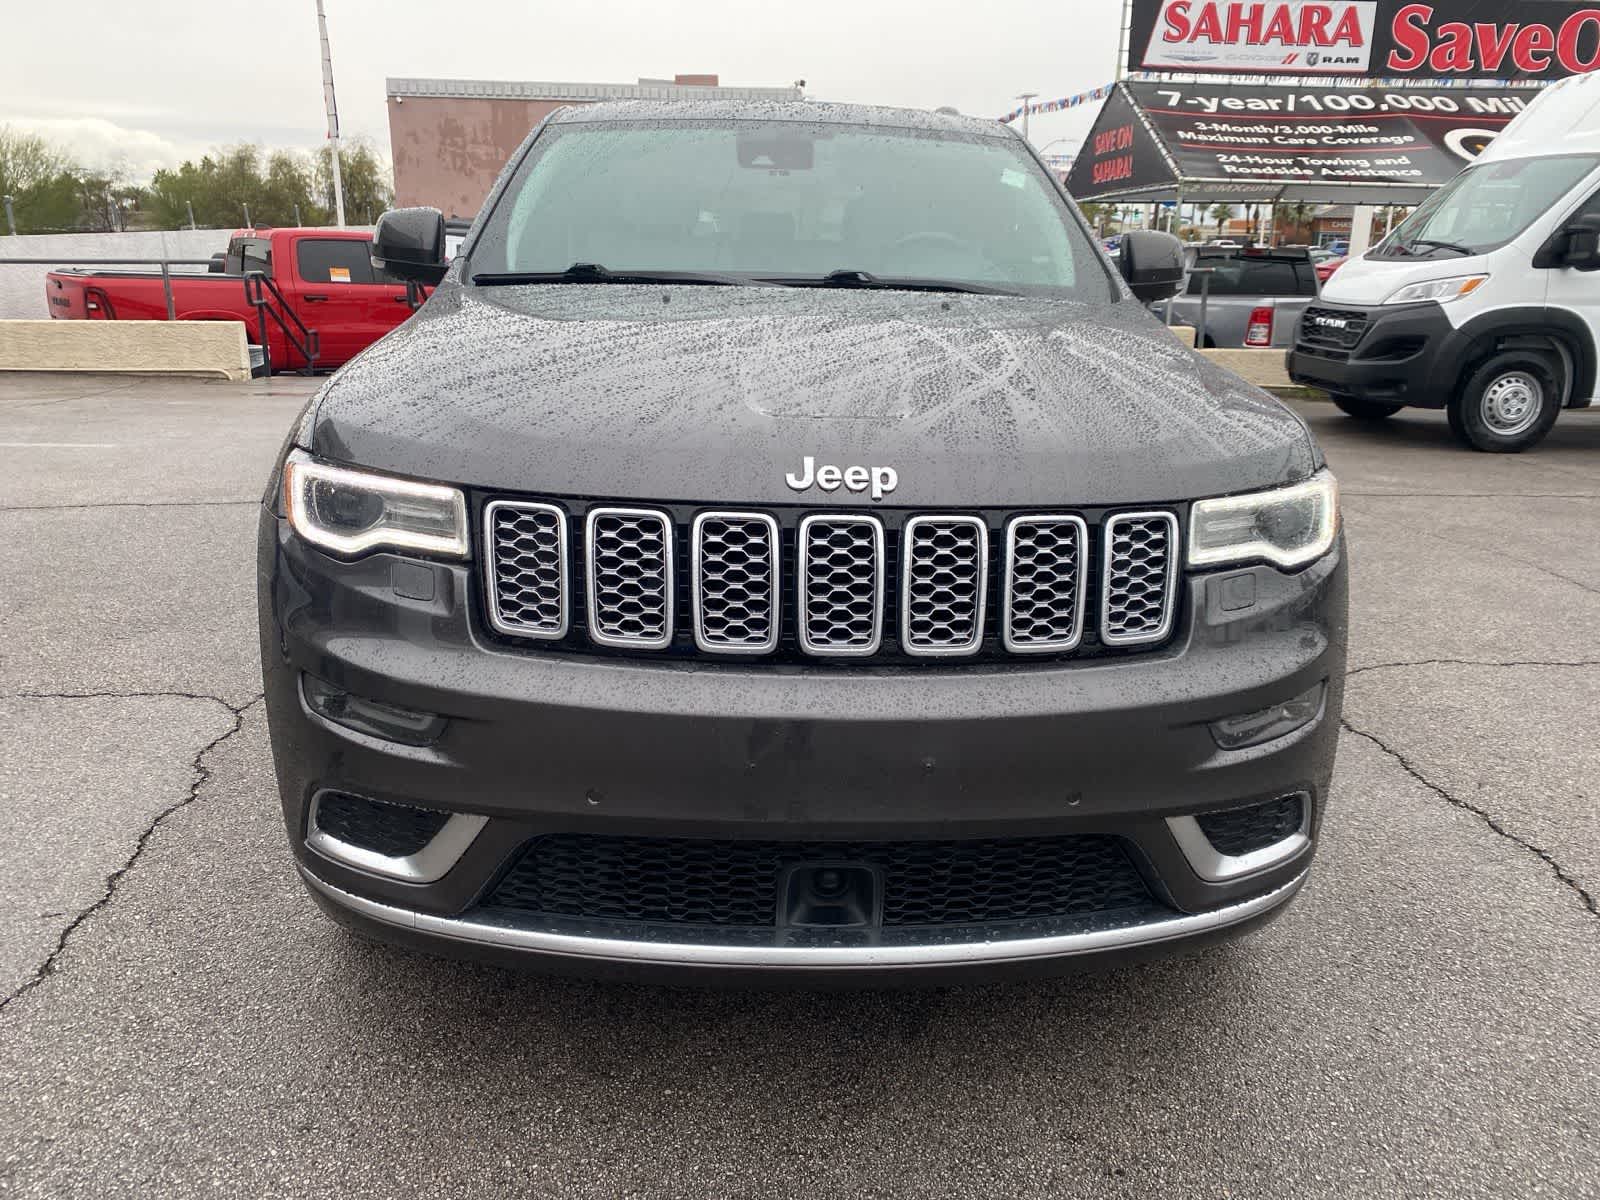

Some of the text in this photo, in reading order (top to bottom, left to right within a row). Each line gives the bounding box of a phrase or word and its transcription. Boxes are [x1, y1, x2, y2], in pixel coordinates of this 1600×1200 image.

[1163, 0, 1364, 47] SAHARA
[1322, 56, 1360, 64] RAM
[1095, 123, 1134, 156] SAVE ON
[1177, 131, 1415, 146] Maximum Care Coverage
[1216, 154, 1411, 167] 24-Hour Towing and
[1223, 164, 1423, 177] Roadside Assistance
[1315, 317, 1346, 328] RAM
[785, 456, 898, 501] Jeep
